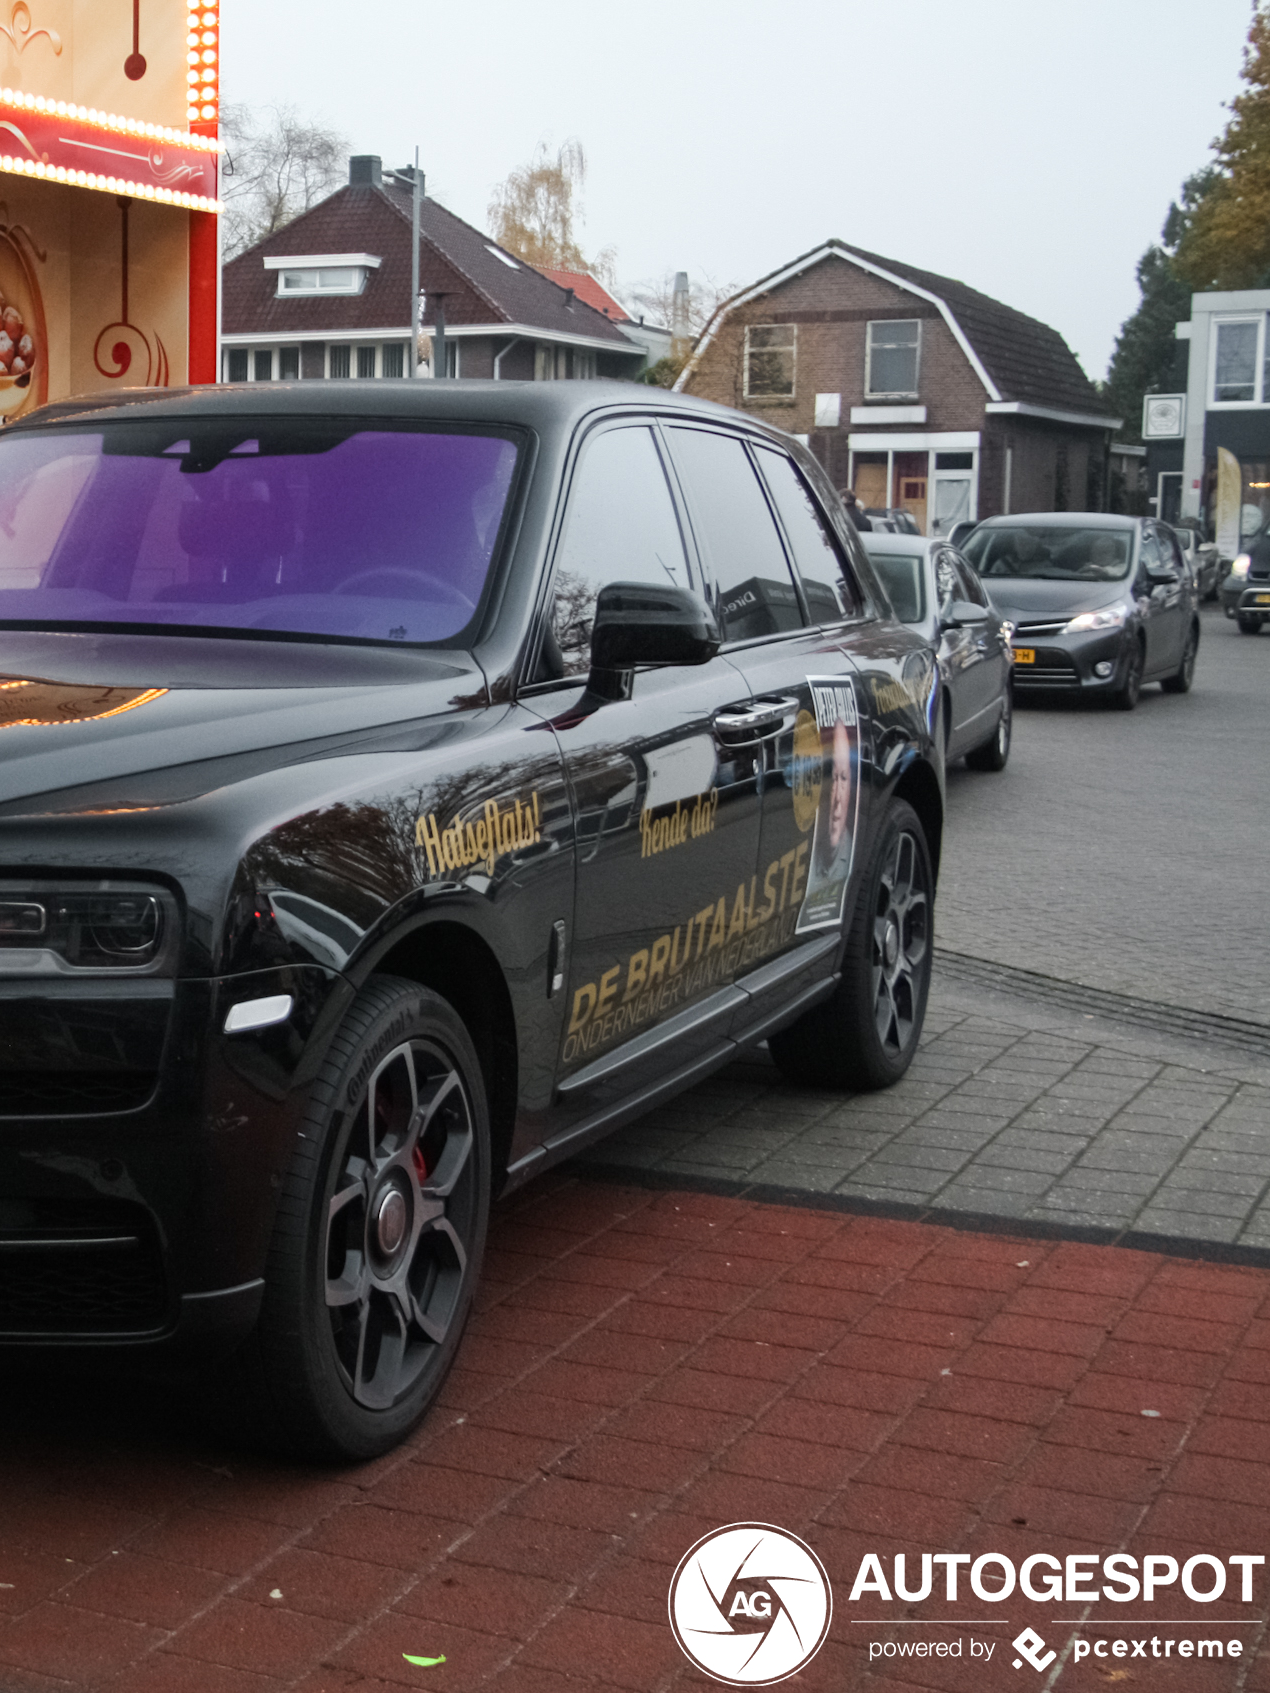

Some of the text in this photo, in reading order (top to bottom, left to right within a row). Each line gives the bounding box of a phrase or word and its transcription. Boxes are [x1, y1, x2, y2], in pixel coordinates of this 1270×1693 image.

[415, 791, 541, 877] Hatseflats!
[639, 786, 718, 858] Kende da?
[562, 906, 797, 1063] ONDERNEMER VAN NEDERLAND
[567, 839, 809, 1035] DE BRUTAALSTE
